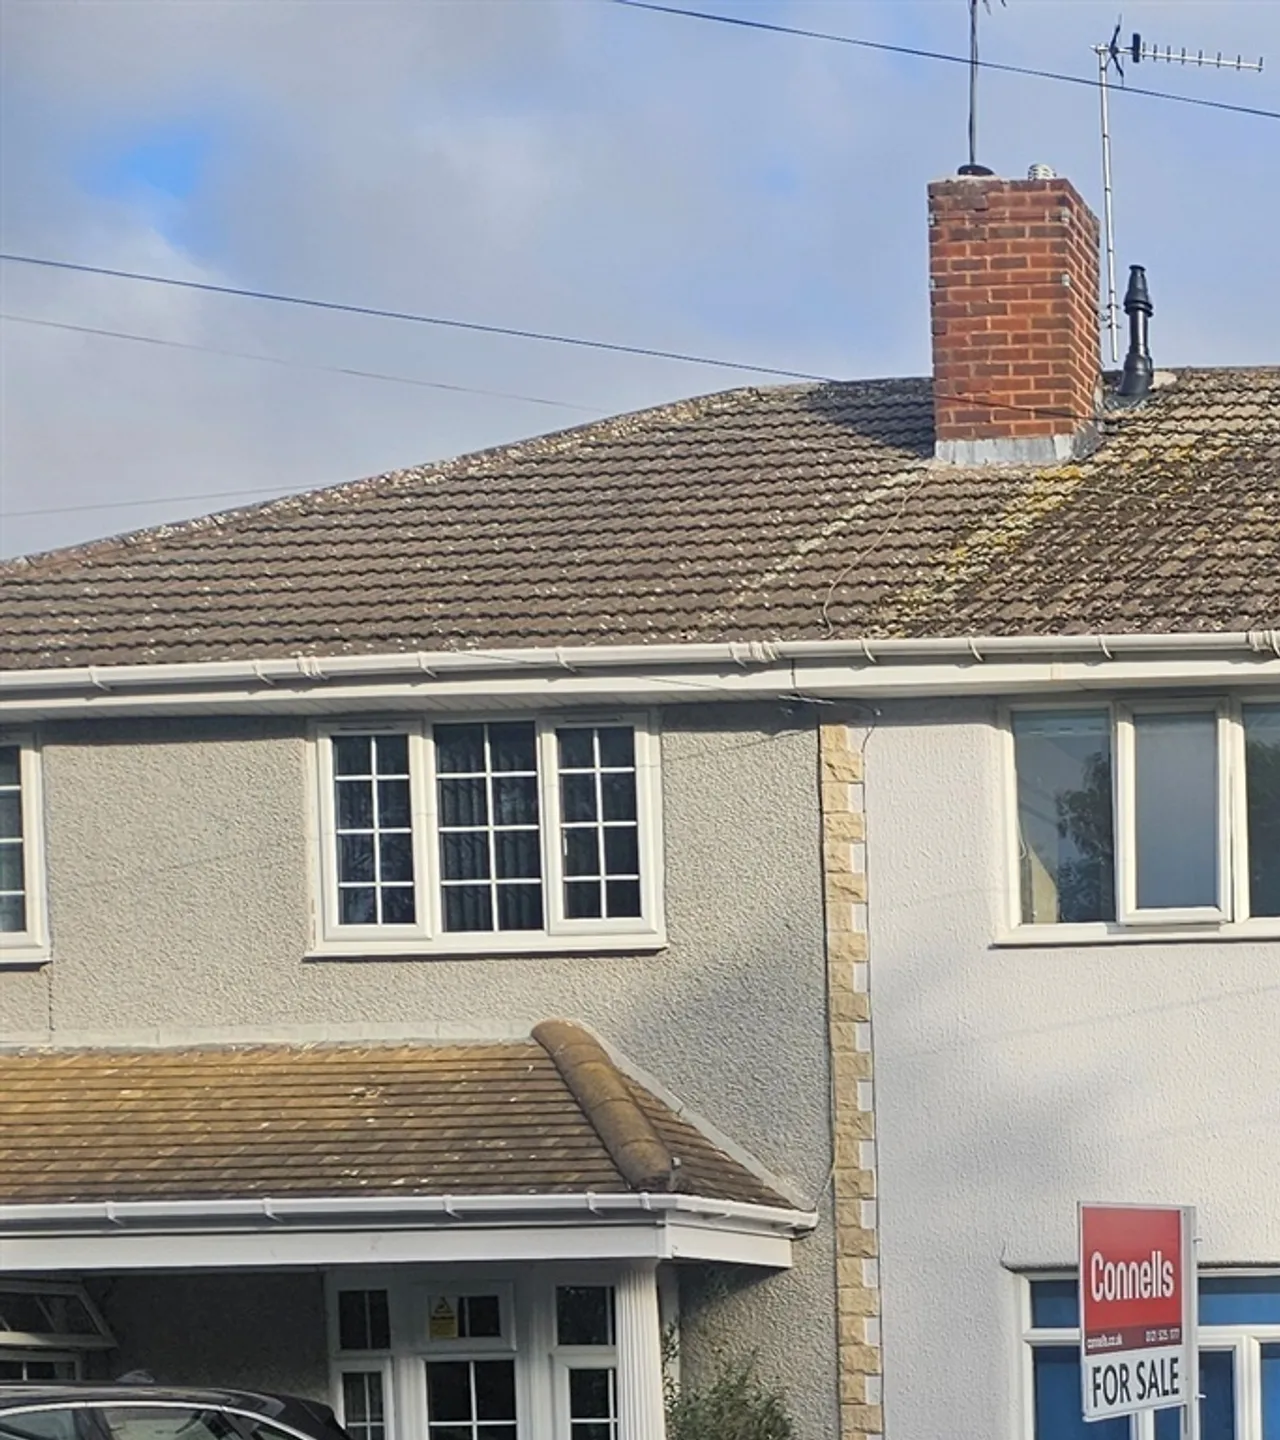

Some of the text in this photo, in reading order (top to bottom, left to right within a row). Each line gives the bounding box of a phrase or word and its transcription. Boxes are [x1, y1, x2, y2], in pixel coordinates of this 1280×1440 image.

[1091, 1250, 1174, 1302] Connells
[1092, 1356, 1179, 1408] FOR SALE
